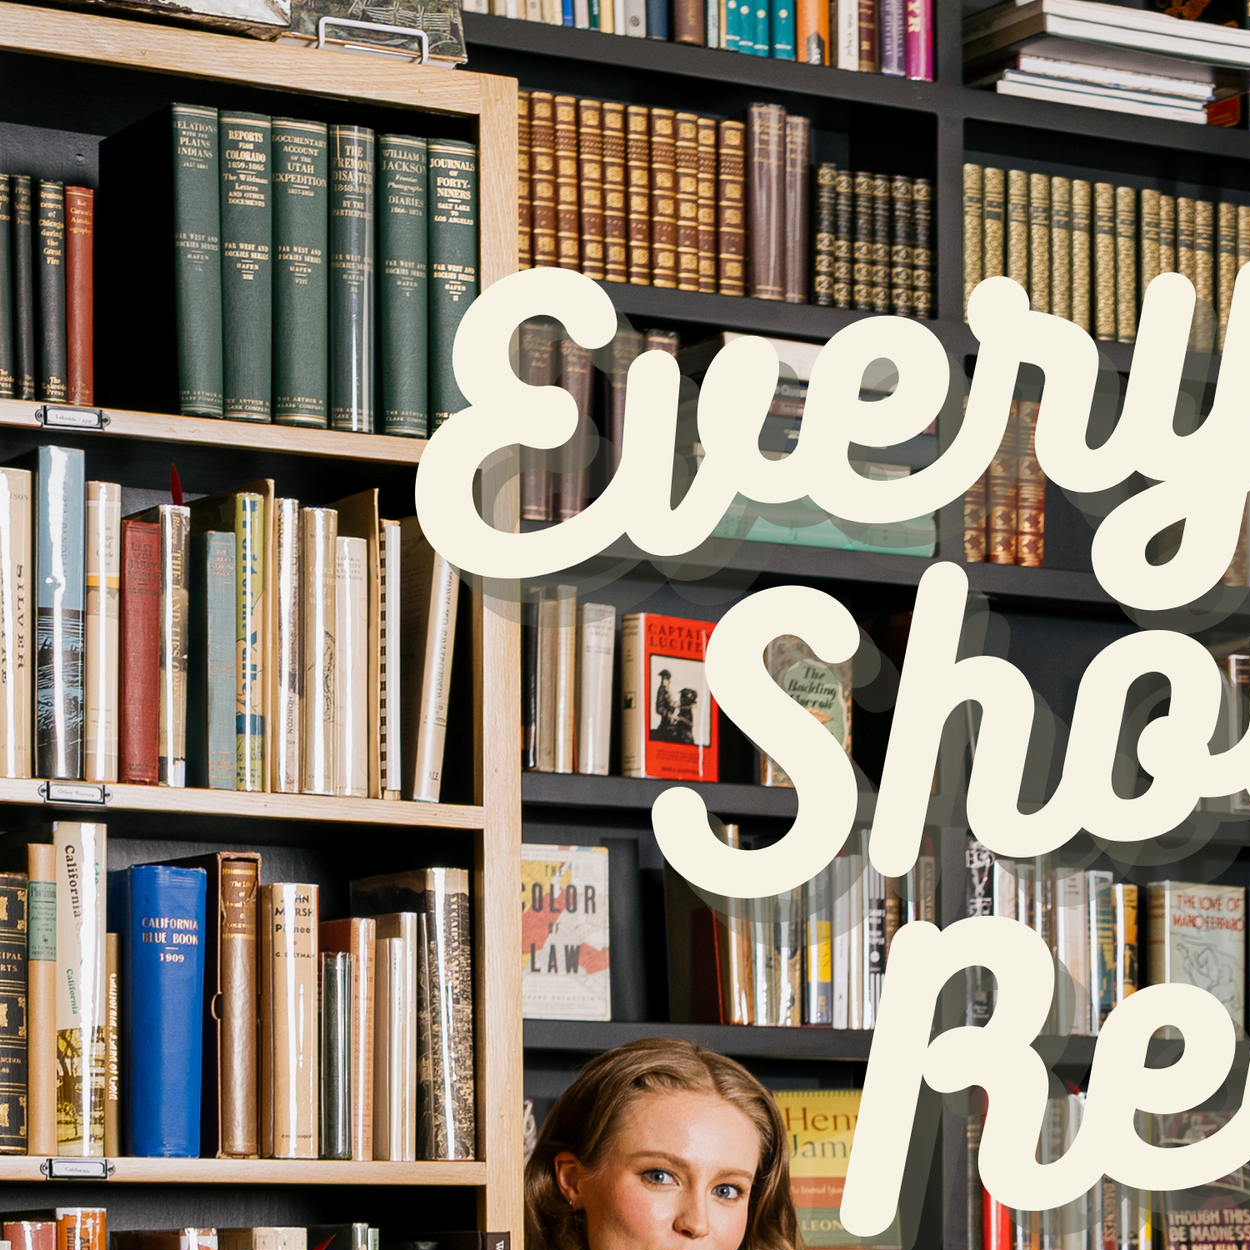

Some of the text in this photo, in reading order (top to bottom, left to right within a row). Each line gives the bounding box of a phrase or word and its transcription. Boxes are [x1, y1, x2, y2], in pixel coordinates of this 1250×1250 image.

[180, 137, 210, 148] PLAINS
[229, 130, 264, 143] REPORTS
[178, 147, 213, 159] INDIANS
[225, 150, 267, 163] COLORADO
[283, 145, 319, 157] ACCOUNT
[345, 145, 363, 157] THE
[382, 149, 419, 162] WILLIAM
[288, 162, 315, 174] UTAH
[429, 158, 475, 172] JOURNALS
[223, 173, 237, 181] The
[272, 173, 327, 188] EXPEDITION
[437, 177, 471, 189] FORTY-
[235, 183, 259, 192] Letters
[437, 188, 471, 200] NINERS
[388, 195, 424, 208] DIARIES
[437, 203, 453, 211] SALT
[448, 216, 474, 226] ANGELES
[238, 243, 255, 251] WEST
[16, 564, 25, 670] SILVER
[805, 666, 826, 680] The
[545, 865, 563, 877] THE
[65, 844, 81, 918] California
[1176, 894, 1241, 912] THE LOVE OF
[142, 917, 198, 930] CALIFORNIA
[548, 922, 559, 934] OF
[143, 932, 198, 945] BLUE BOOK
[160, 953, 185, 963] 1909
[530, 944, 580, 974] LAW
[66, 968, 77, 1015] California
[1168, 1210, 1221, 1225] THOUGH
[1169, 1226, 1187, 1241] BE
